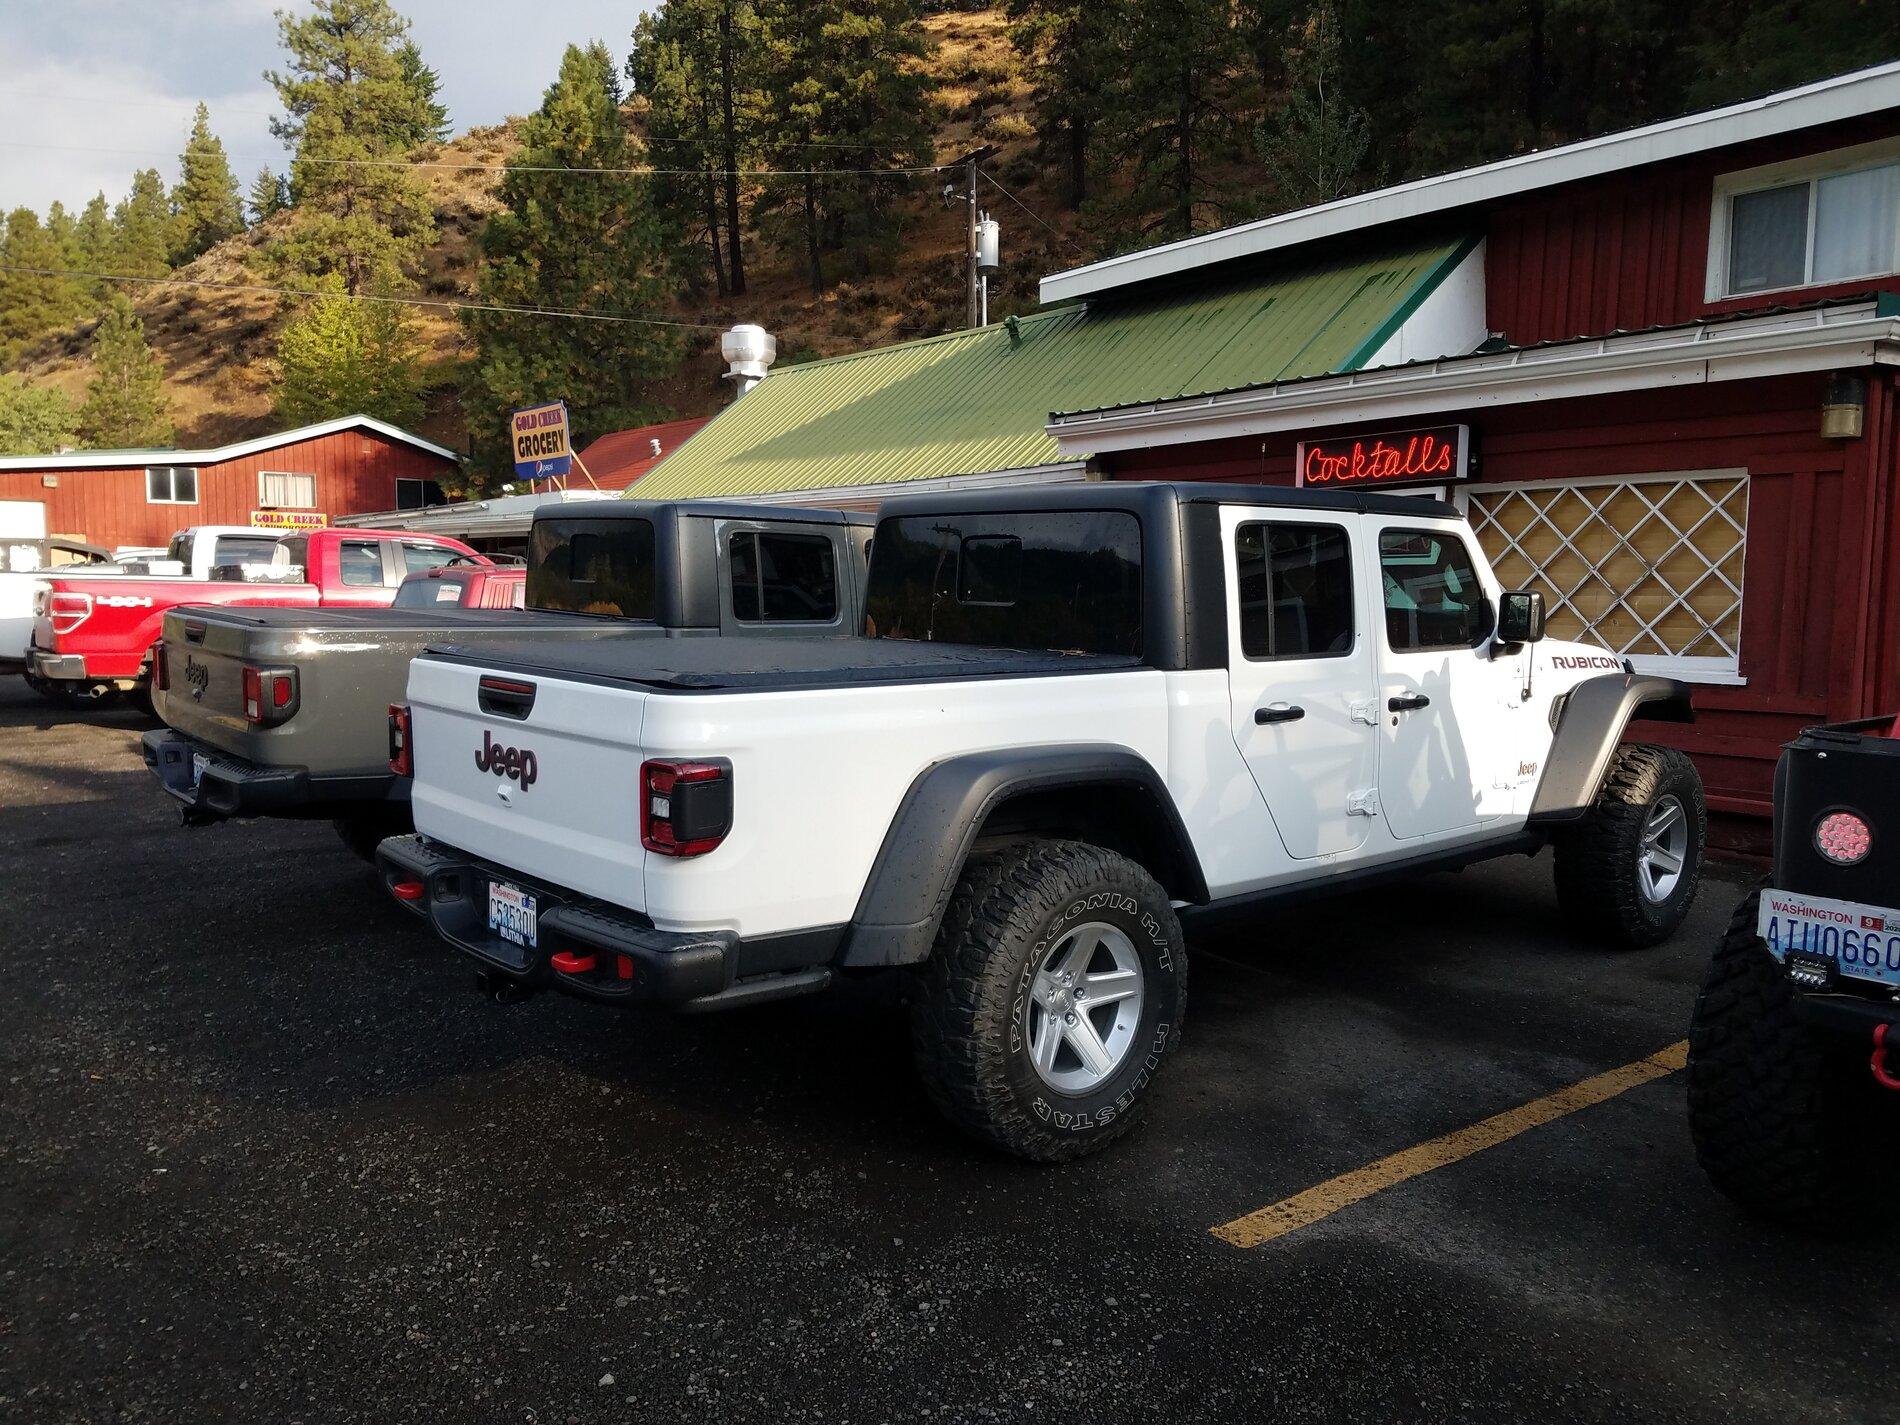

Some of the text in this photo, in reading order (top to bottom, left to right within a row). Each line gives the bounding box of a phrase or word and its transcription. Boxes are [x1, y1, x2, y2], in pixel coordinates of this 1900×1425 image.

[516, 409, 562, 431] GOLD CREEK
[518, 429, 564, 458] GROCERY
[255, 514, 323, 525] GOLD CREEK
[1552, 656, 1620, 669] RUBICON
[475, 730, 537, 792] Jeep
[1518, 761, 1537, 776] Jeep
[492, 886, 520, 903] WASHINGTON
[1771, 900, 1853, 924] WASHINGTON
[1865, 917, 1873, 927] 9
[1141, 913, 1174, 972] M/T
[1844, 964, 1870, 975] STATE
[1032, 1023, 1170, 1131] MILESTAR
